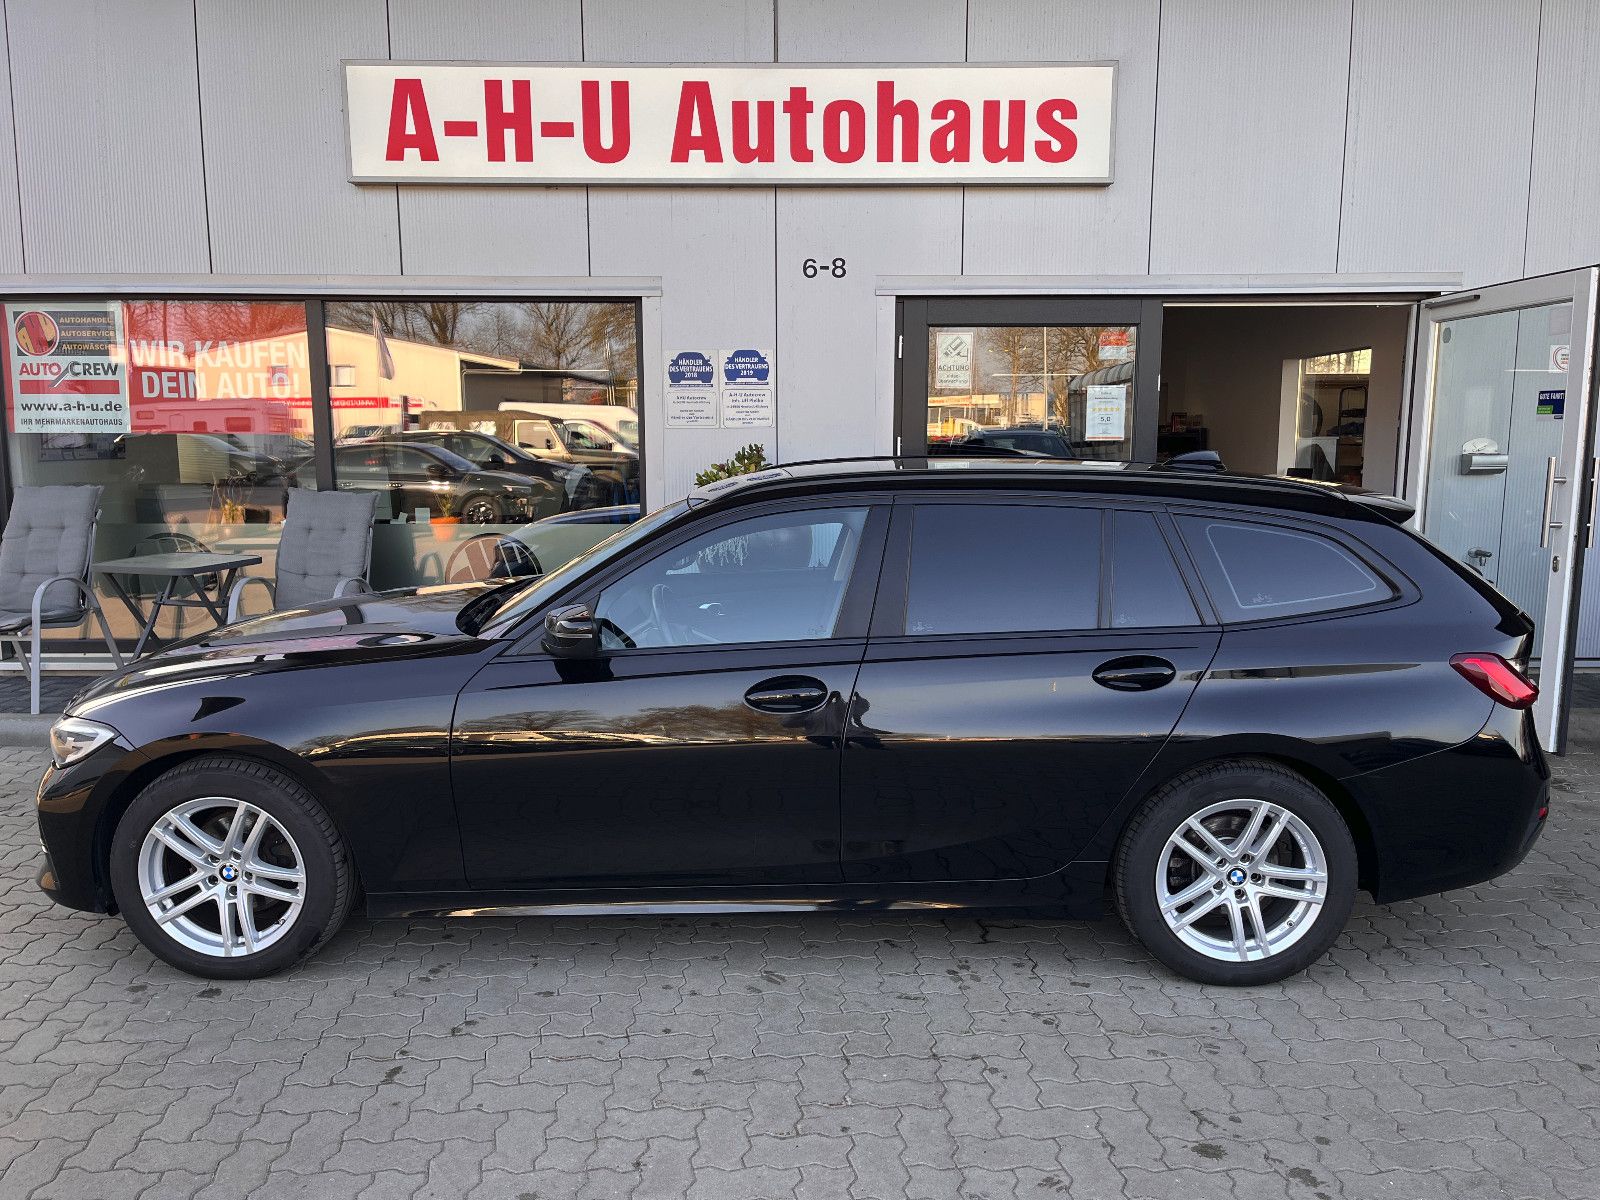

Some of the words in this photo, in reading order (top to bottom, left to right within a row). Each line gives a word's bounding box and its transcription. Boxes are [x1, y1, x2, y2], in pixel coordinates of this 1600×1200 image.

[385, 78, 630, 163] A-H-U
[671, 80, 1078, 164] Autohaus
[803, 258, 847, 279] 6-8
[130, 339, 188, 368] WIR
[195, 340, 306, 369] KAUFEN
[19, 362, 62, 376] AUTO
[69, 361, 118, 376] CREW
[142, 371, 205, 398] DEIN
[216, 372, 301, 398] AUTO!
[21, 401, 122, 412] www.a-h-u.de
